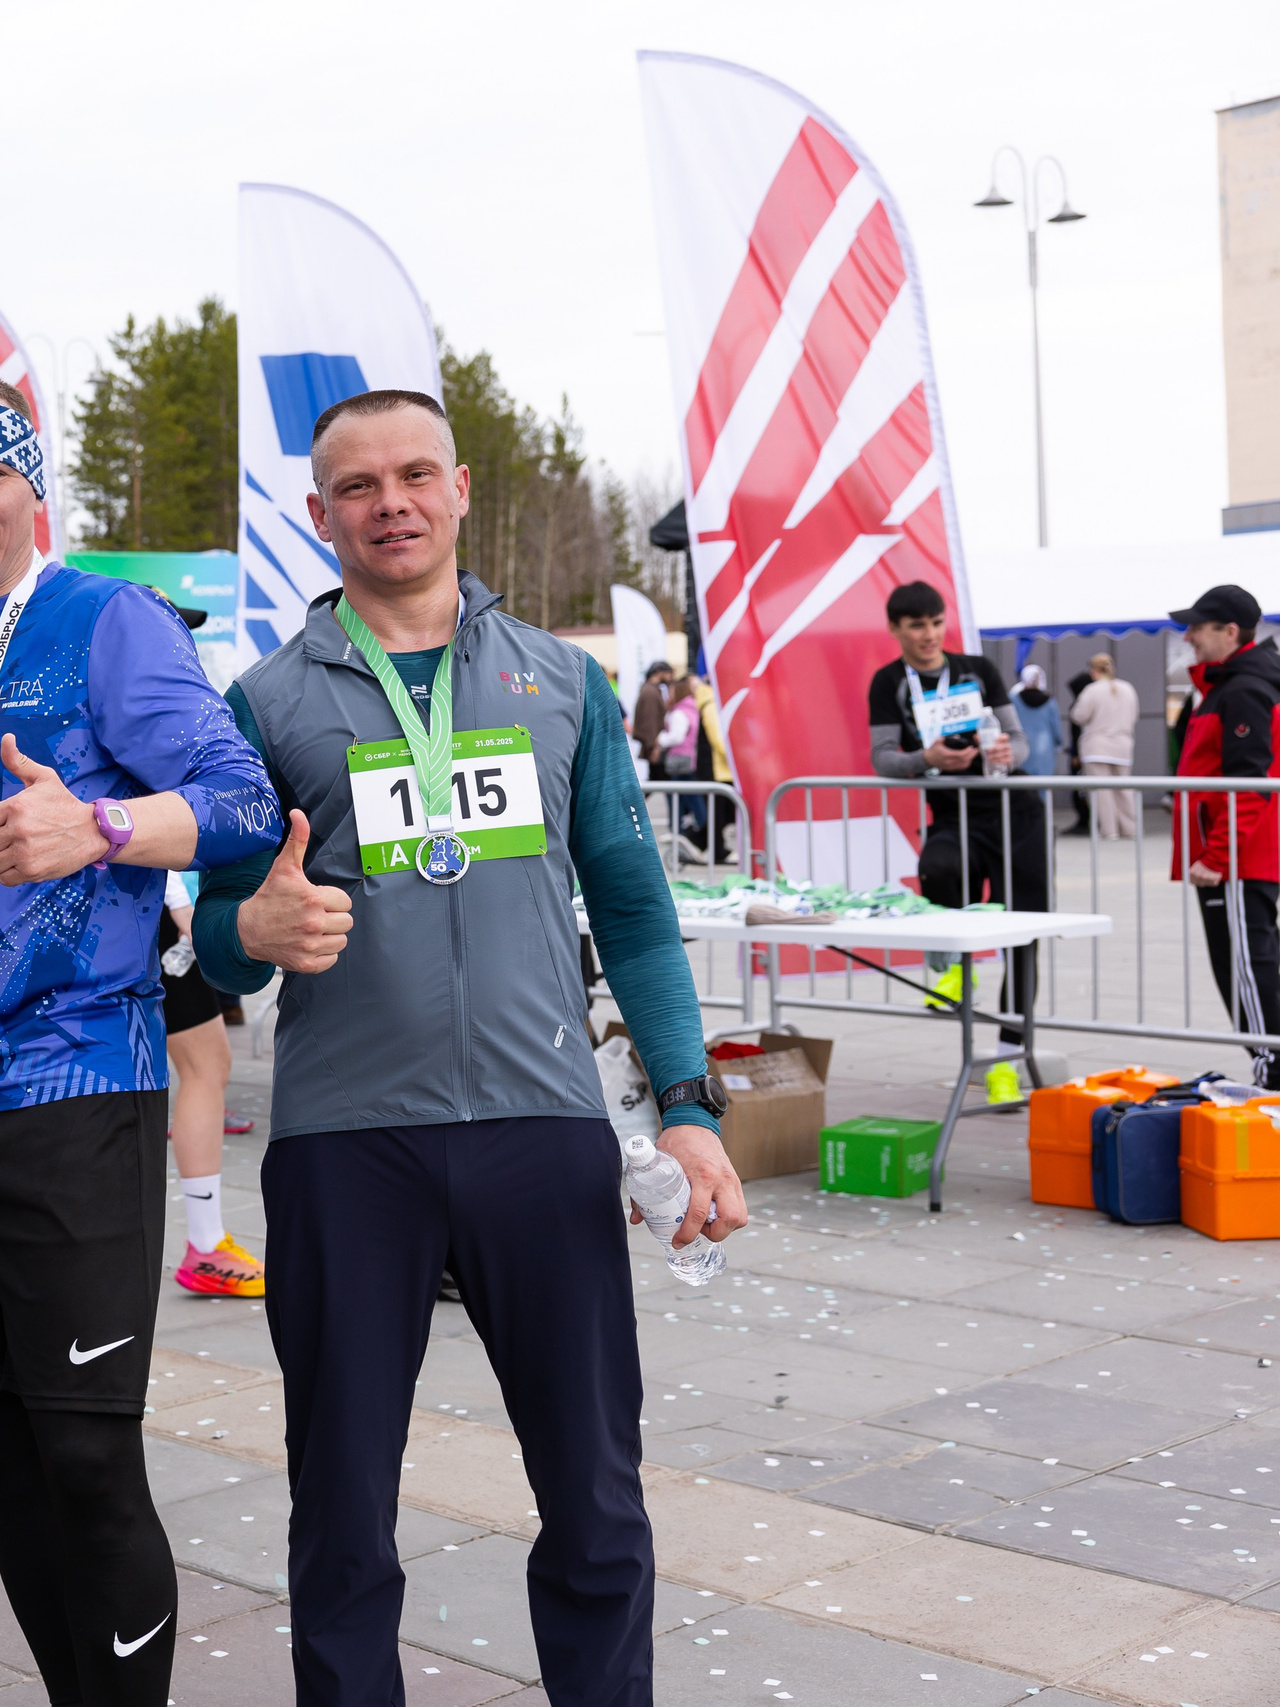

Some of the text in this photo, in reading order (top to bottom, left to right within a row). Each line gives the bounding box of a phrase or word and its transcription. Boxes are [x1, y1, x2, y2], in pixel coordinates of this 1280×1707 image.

[475, 737, 513, 747] 31.05.2025
[373, 752, 390, 760] СБЕР
[389, 768, 507, 827] 115
[390, 843, 410, 867] A
[431, 863, 447, 873] 50
